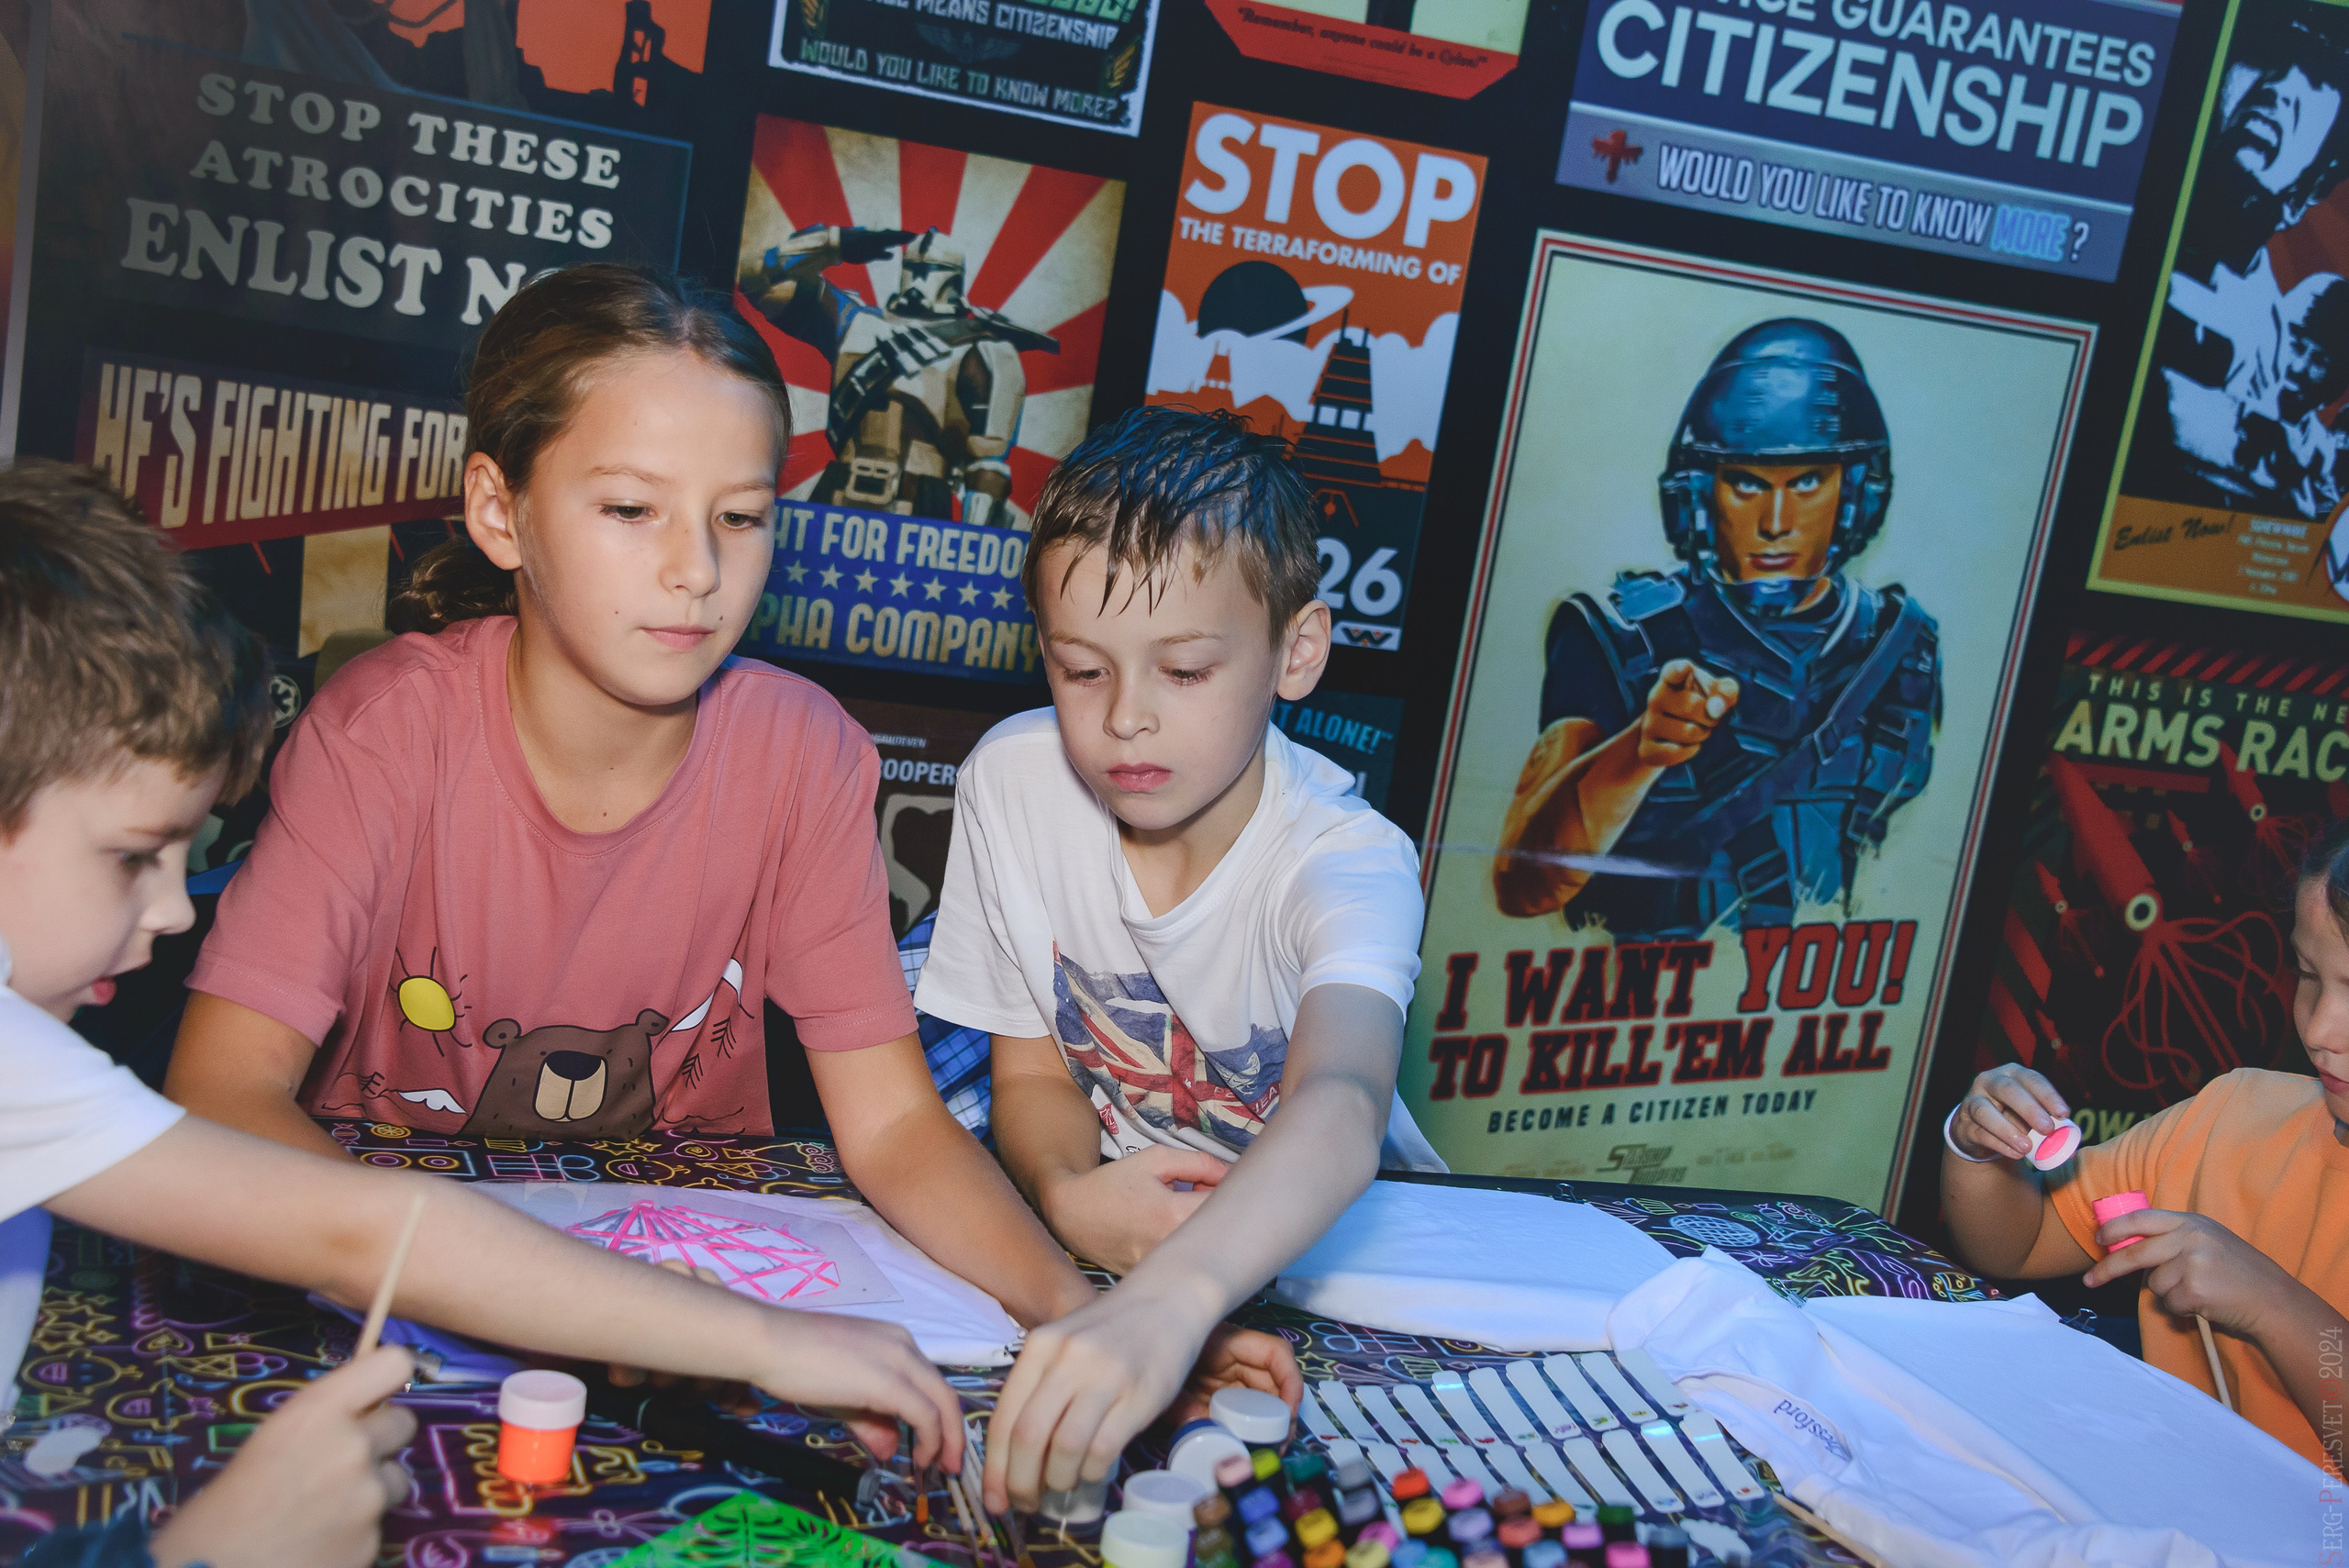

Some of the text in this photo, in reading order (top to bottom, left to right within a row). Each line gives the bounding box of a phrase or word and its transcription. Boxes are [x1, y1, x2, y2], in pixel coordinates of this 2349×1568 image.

[799, 38, 1118, 120] WOULD YOU LIKE TO KNOW MORE?
[1598, 0, 2143, 167] CITIZENSHIP
[1831, 0, 2156, 87] GUARANTEES
[196, 73, 621, 188] STOP THESE
[189, 139, 614, 249] ATROCITIES
[1184, 112, 1476, 249] STOP
[1658, 144, 1751, 203] WOULD
[1760, 163, 1809, 214] YOU
[1816, 174, 1872, 225] LIKE
[1876, 184, 1908, 231] TO
[1911, 195, 1993, 246] KNOW
[1991, 205, 2071, 261] MORE
[121, 197, 442, 317] ENLIST
[1179, 217, 1462, 285] THE TERRAFORMING OF
[202, 379, 392, 525] FIGHTING
[395, 406, 468, 503] FOR
[820, 512, 889, 562] FOR
[896, 522, 1030, 579] FREEDO
[845, 602, 1043, 673] COMPANY
[2054, 699, 2225, 768] ARMS
[2089, 673, 2163, 702] THIS
[2183, 686, 2211, 707] IS
[2235, 692, 2292, 718] THE
[880, 758, 959, 786] OOPER
[1435, 919, 1919, 1030] I WANT YOU!
[1429, 1011, 1893, 1101] TO KILL'EM ALL
[1486, 1089, 1818, 1133] BECOME A CITIZEN TODAY
